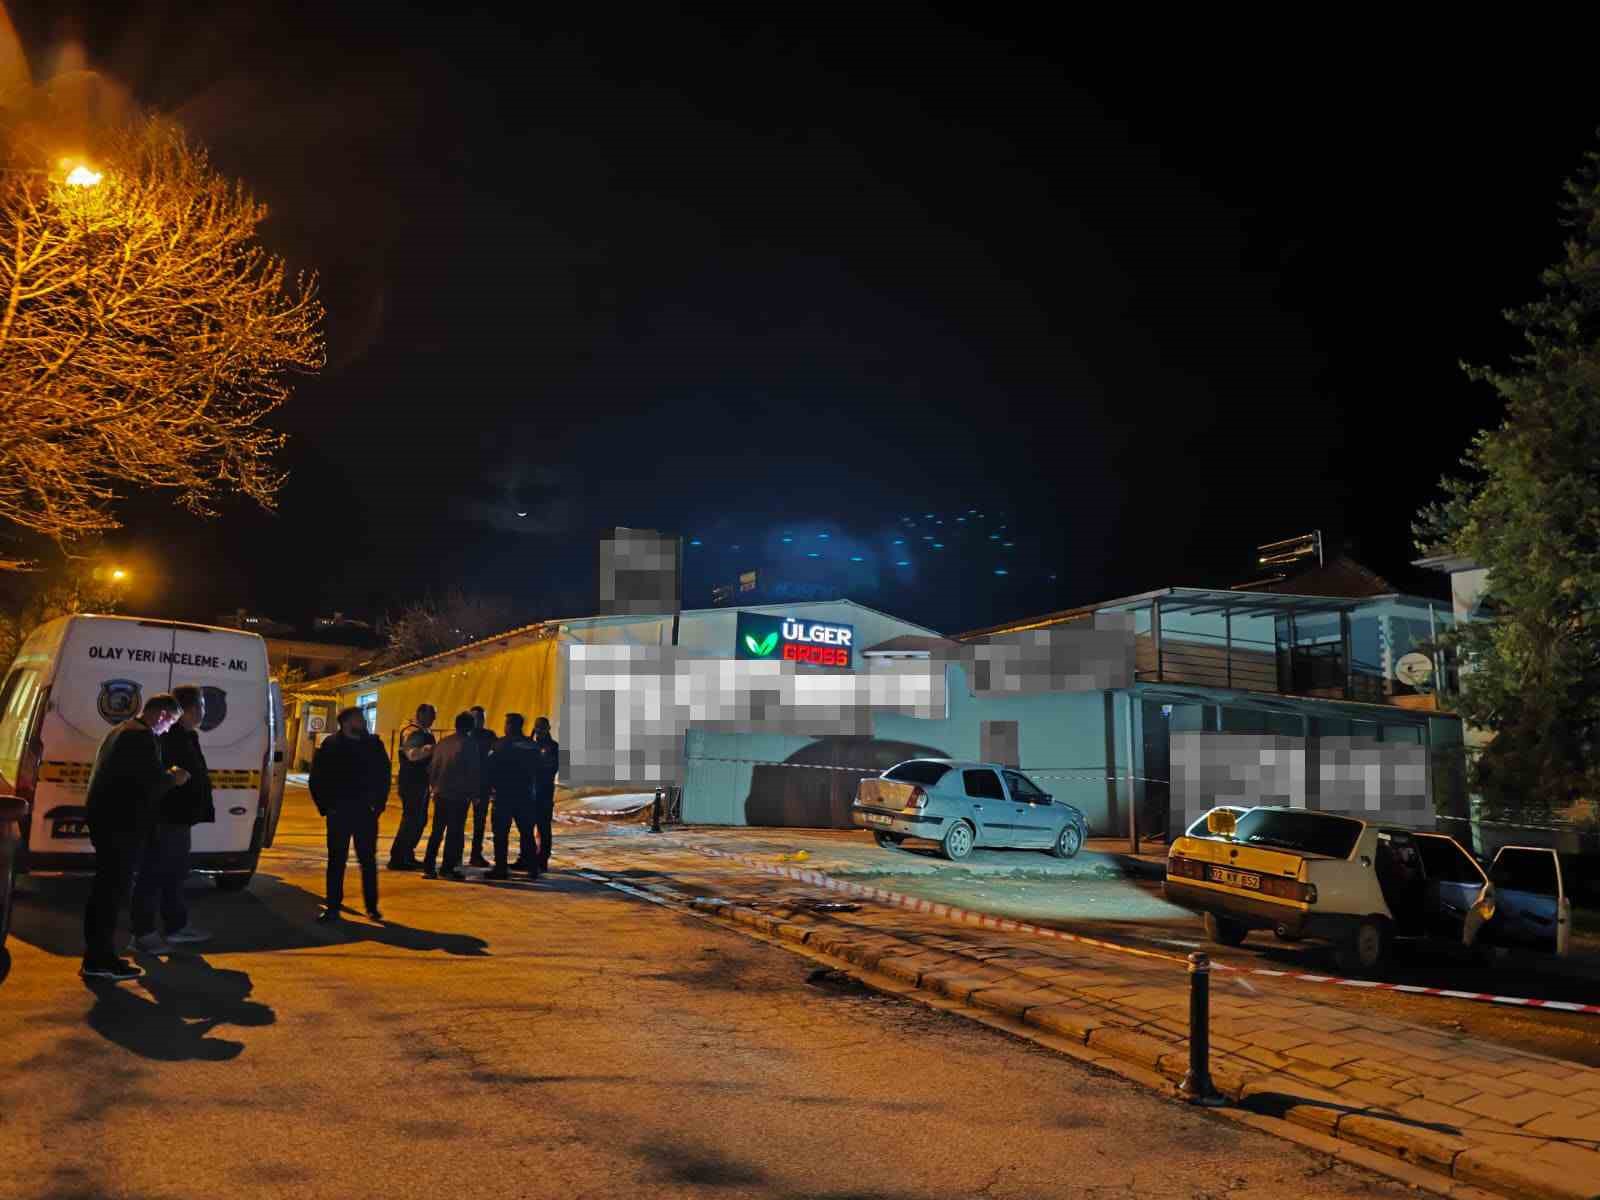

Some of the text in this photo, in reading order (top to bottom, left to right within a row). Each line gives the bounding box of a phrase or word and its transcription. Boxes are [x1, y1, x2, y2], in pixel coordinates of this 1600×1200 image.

[782, 618, 852, 646] ÜLGER
[89, 646, 124, 660] OLAY
[783, 643, 849, 666] GROSS
